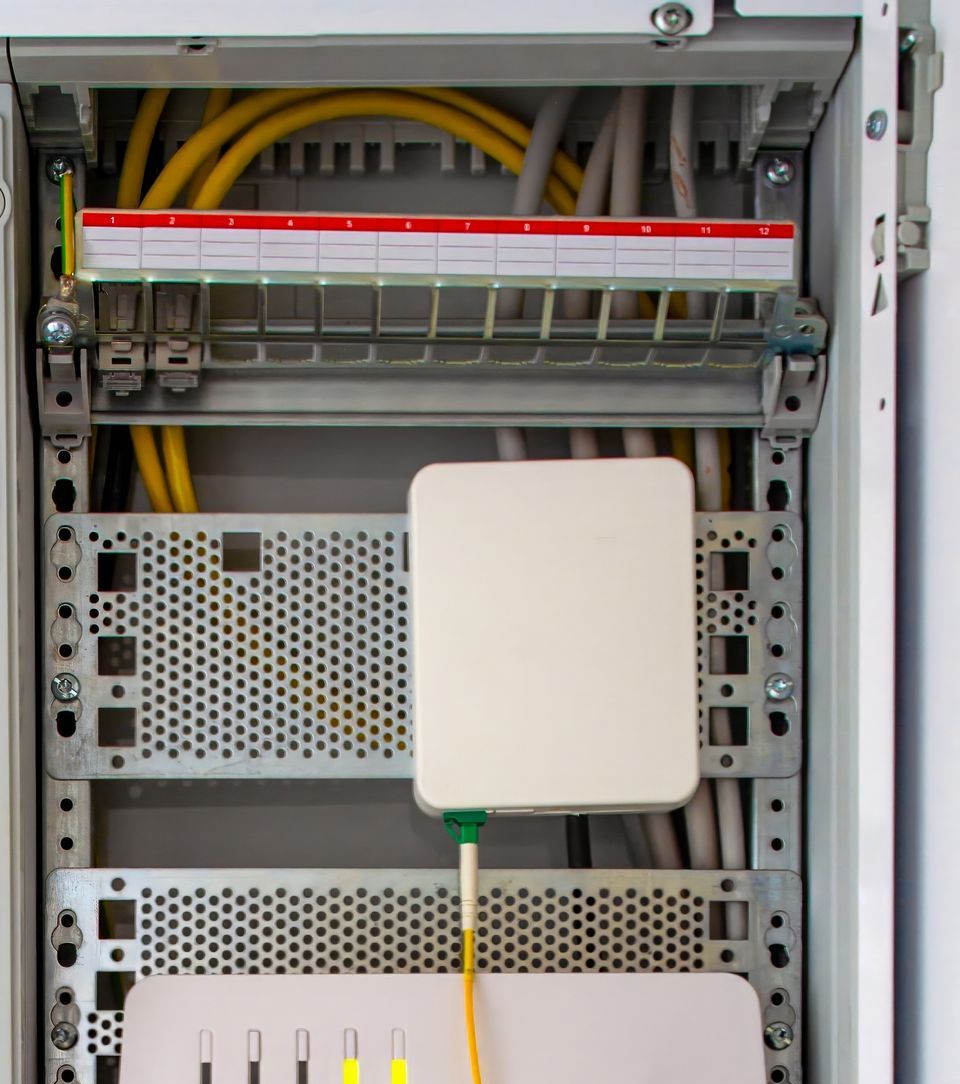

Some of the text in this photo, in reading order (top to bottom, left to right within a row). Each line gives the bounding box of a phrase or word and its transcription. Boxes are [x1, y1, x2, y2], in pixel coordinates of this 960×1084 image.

[110, 216, 115, 224] 1
[169, 217, 175, 225] 2
[229, 218, 234, 226] 3
[347, 220, 352, 228] 5
[465, 223, 470, 231] 7
[759, 227, 770, 235] 12
